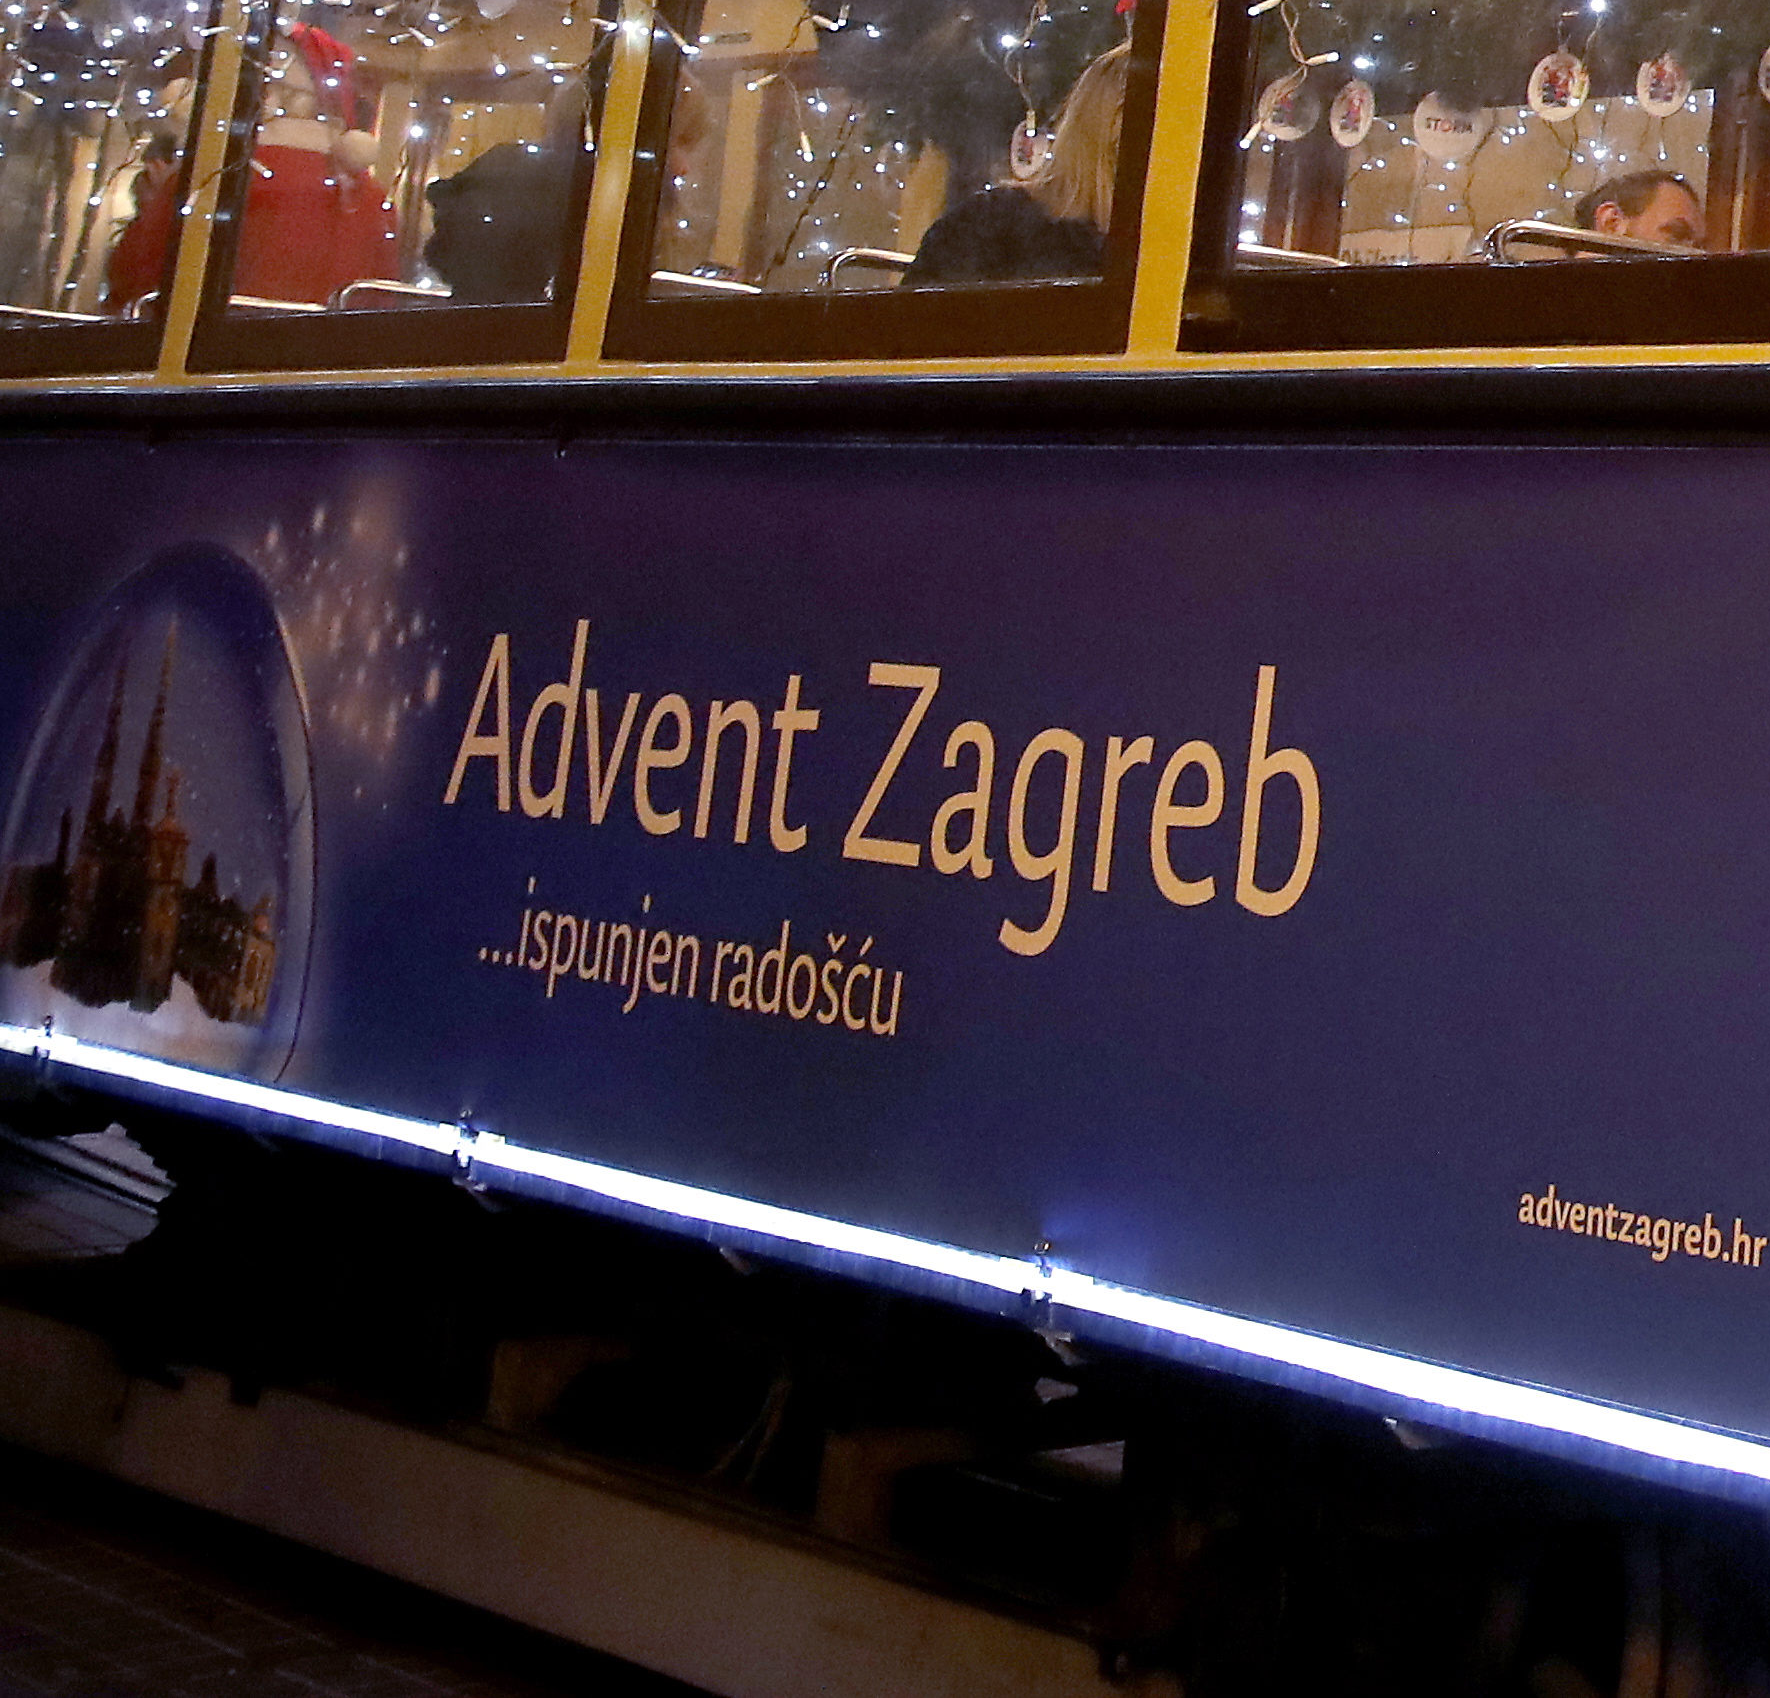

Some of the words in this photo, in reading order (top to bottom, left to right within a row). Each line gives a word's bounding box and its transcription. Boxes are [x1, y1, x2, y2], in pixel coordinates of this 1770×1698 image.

[443, 619, 821, 853] Advent
[842, 662, 1321, 957] Zagreb
[479, 877, 700, 1014] ...ispunjen
[710, 920, 903, 1036] radošću
[1518, 1183, 1768, 1268] adventzagreb.hr
